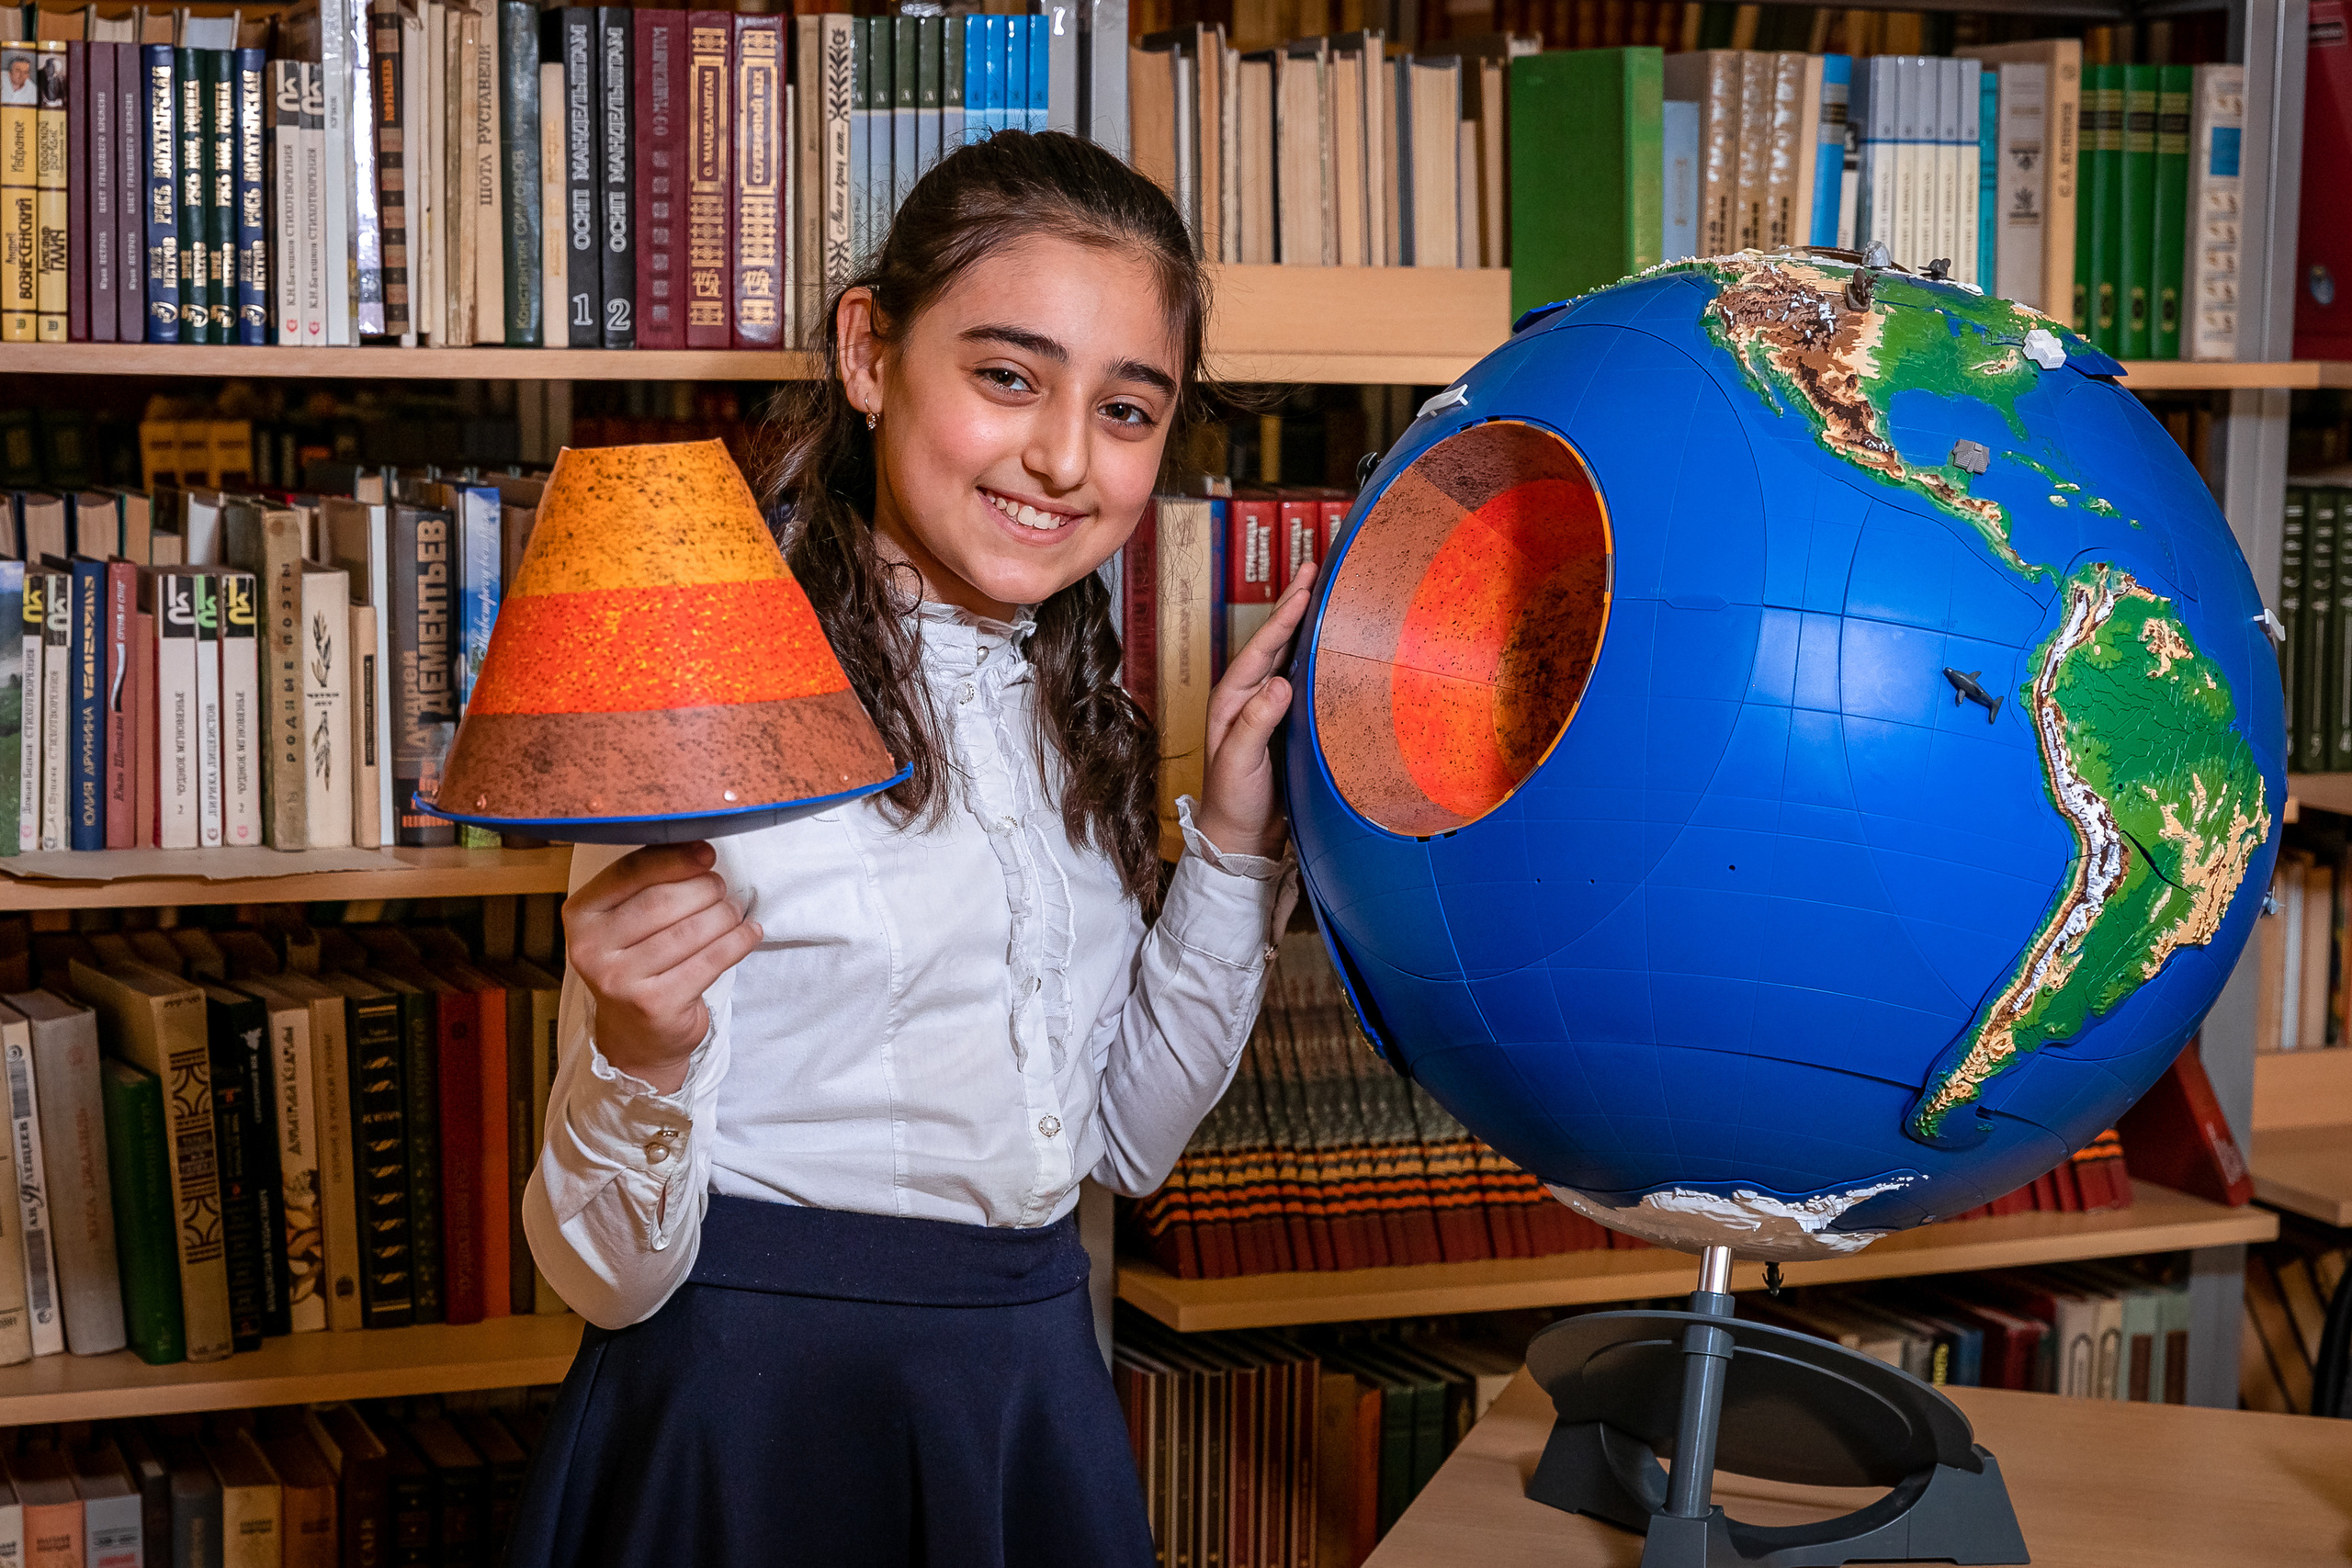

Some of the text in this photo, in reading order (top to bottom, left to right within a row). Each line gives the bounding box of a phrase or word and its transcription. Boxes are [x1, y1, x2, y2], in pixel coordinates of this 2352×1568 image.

[183, 79, 204, 133] РОДИНА
[214, 80, 235, 134] РОДИНА
[477, 43, 493, 206] ШОТА РУСТАВЕЛИ
[152, 65, 174, 225] РУСЬ БОГАТЫРСКАЯ
[241, 69, 262, 227] РУСЬ БОГАТЫРСКАЯ
[185, 173, 202, 207] РУСЬ
[215, 173, 232, 208] РУСЬ
[283, 144, 296, 238] СТИХОТВОРЕНИЯ
[306, 147, 319, 241] СТИХОТВОРЕНИЯ
[571, 189, 591, 251] ОСИП
[19, 197, 33, 299] ВОЗНЕСЕНСКИЙ
[608, 190, 628, 253] ОСИП
[162, 236, 176, 288] ПЕТРОВ
[192, 241, 208, 288] ПЕТРОВ
[222, 242, 236, 288] ПЕТРОВ
[252, 240, 266, 291] ПЕТРОВ
[572, 293, 593, 326] 1
[606, 298, 630, 331] 2
[417, 518, 454, 716] ДЕМЕНТЬЕВ
[280, 563, 298, 763] РОДНЫЕ ПОЭТЫ
[24, 649, 35, 739] СТИХОТВОРЕНИЯ
[175, 691, 186, 753] МГНОВЕНЬЕ
[235, 691, 247, 752] МГНОВЕНЬЕ
[175, 756, 187, 796] ЧУДНОЕ
[206, 703, 219, 818] ЛИРИКА ЛИЦЕИСТОВ
[236, 756, 248, 795] ЧУДНОЕ
[83, 781, 96, 827] ЮЛИЯ
